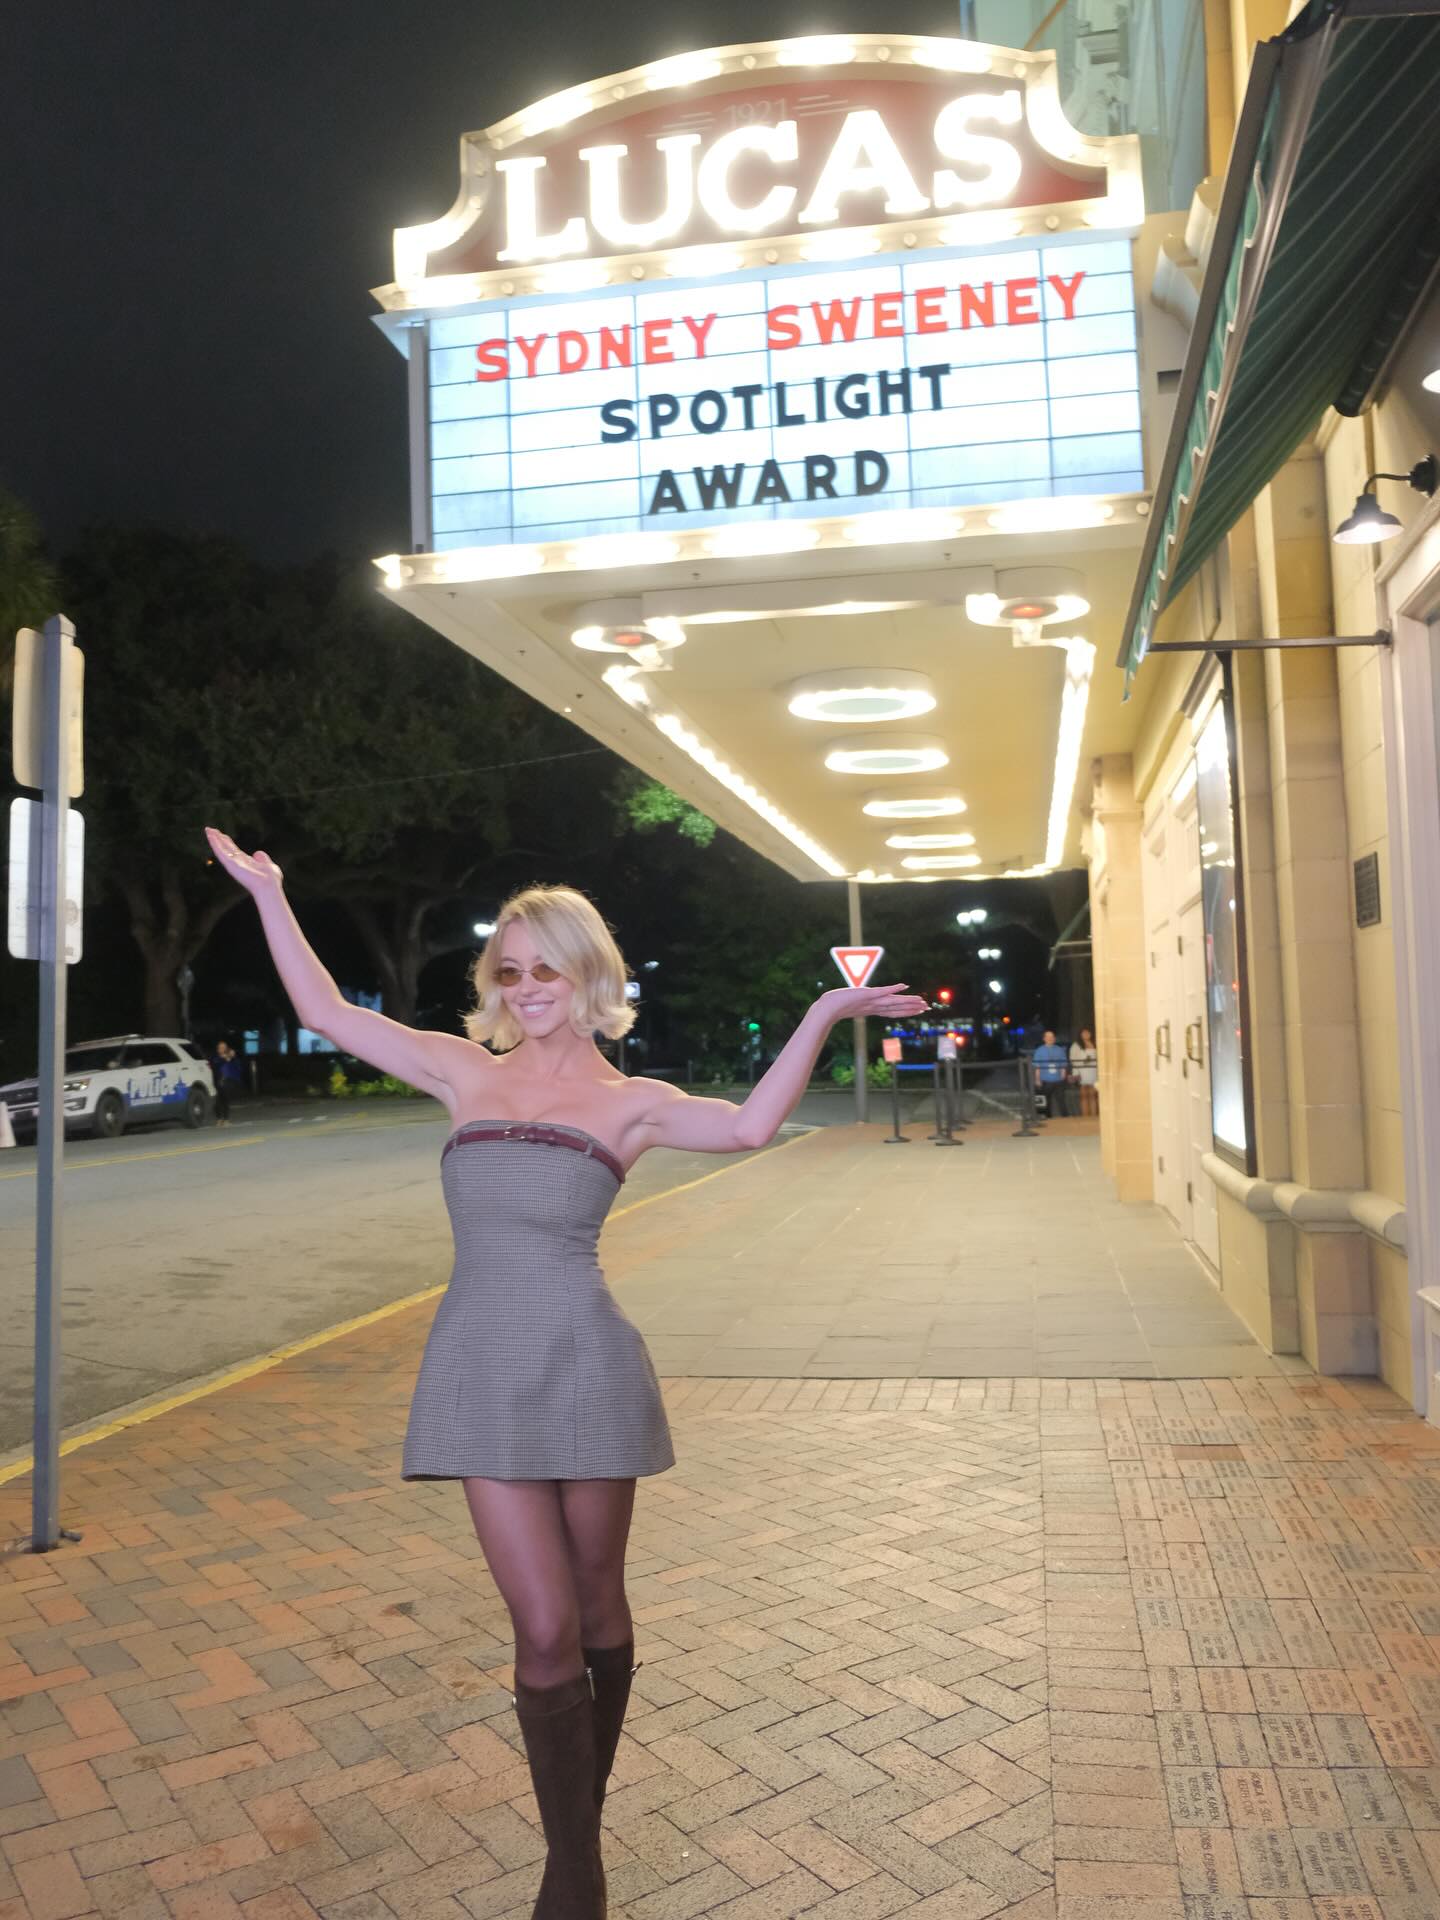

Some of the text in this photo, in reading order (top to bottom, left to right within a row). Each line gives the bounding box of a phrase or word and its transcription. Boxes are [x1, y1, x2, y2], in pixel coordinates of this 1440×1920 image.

[496, 90, 1022, 263] LUCAS
[476, 271, 1086, 382] SYDNEY SWEENEY
[601, 364, 951, 444] SPOTLIGHT
[648, 450, 889, 515] AWARD
